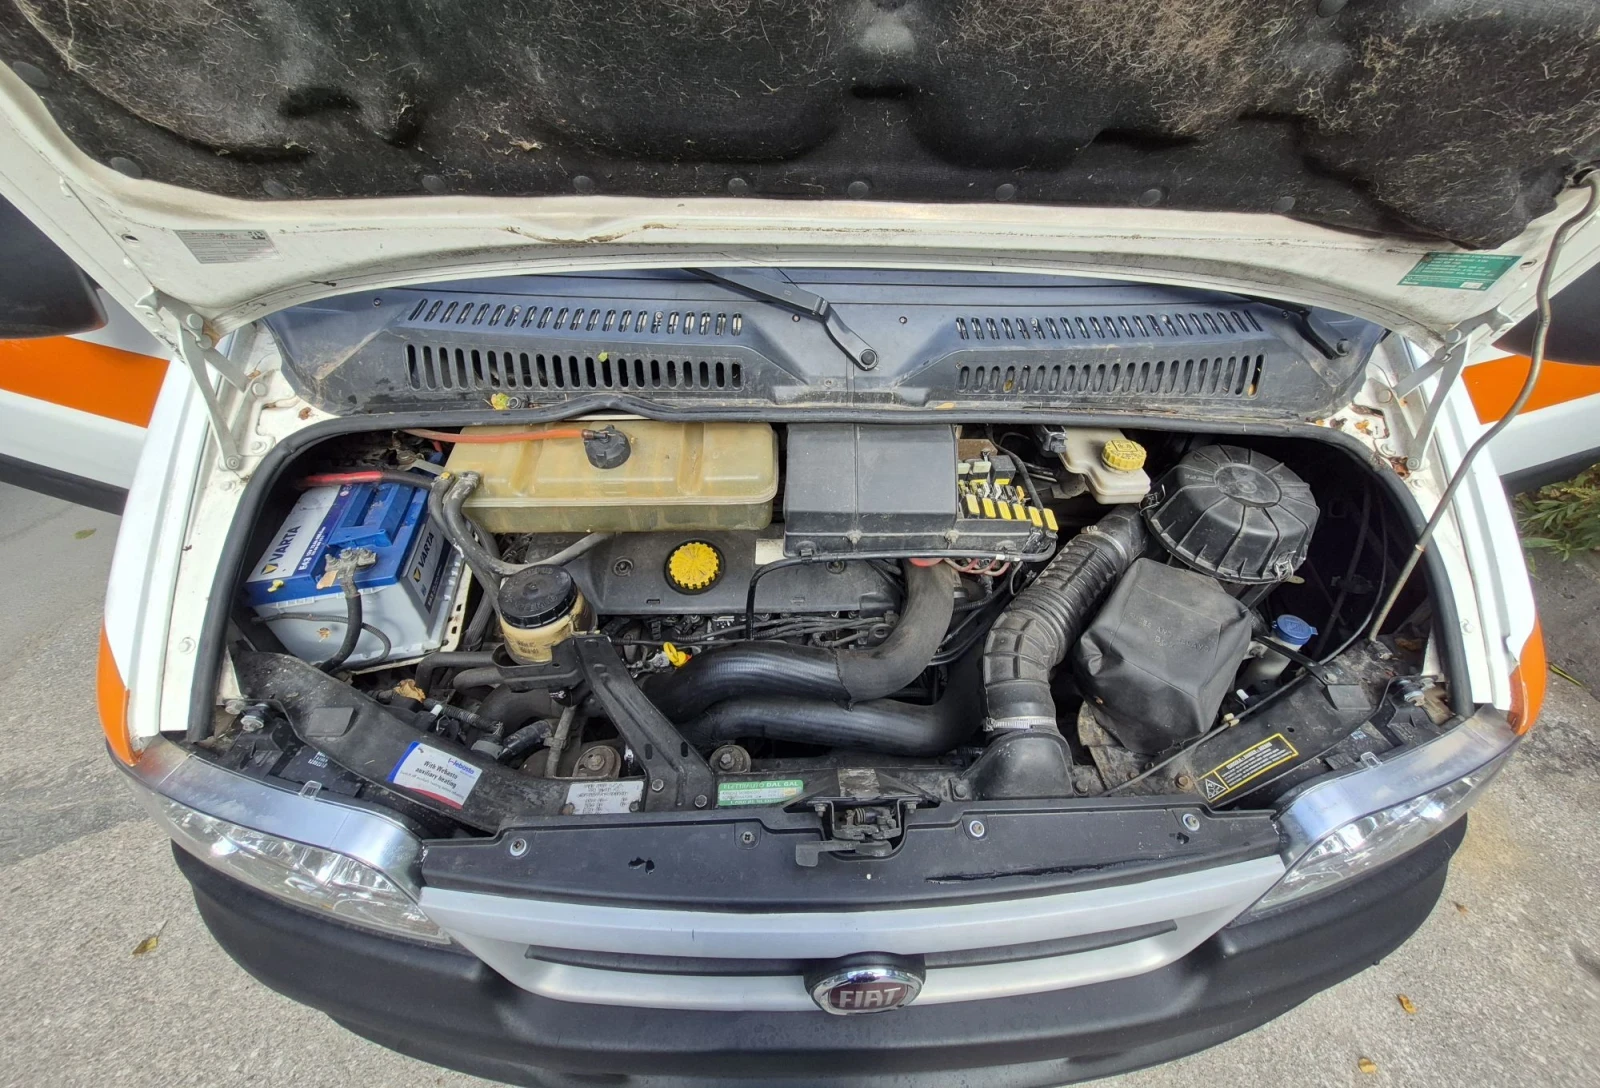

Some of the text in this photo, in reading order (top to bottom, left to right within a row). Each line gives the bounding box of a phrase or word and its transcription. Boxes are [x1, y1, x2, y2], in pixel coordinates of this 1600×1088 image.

[269, 525, 301, 562] VARTA
[418, 531, 435, 568] VARTA
[424, 760, 436, 769] With
[437, 764, 458, 780] Webasto
[448, 757, 475, 775] Webasto
[415, 767, 438, 780] auxiliary
[438, 776, 457, 789] heating
[839, 987, 901, 1008] FIAT
